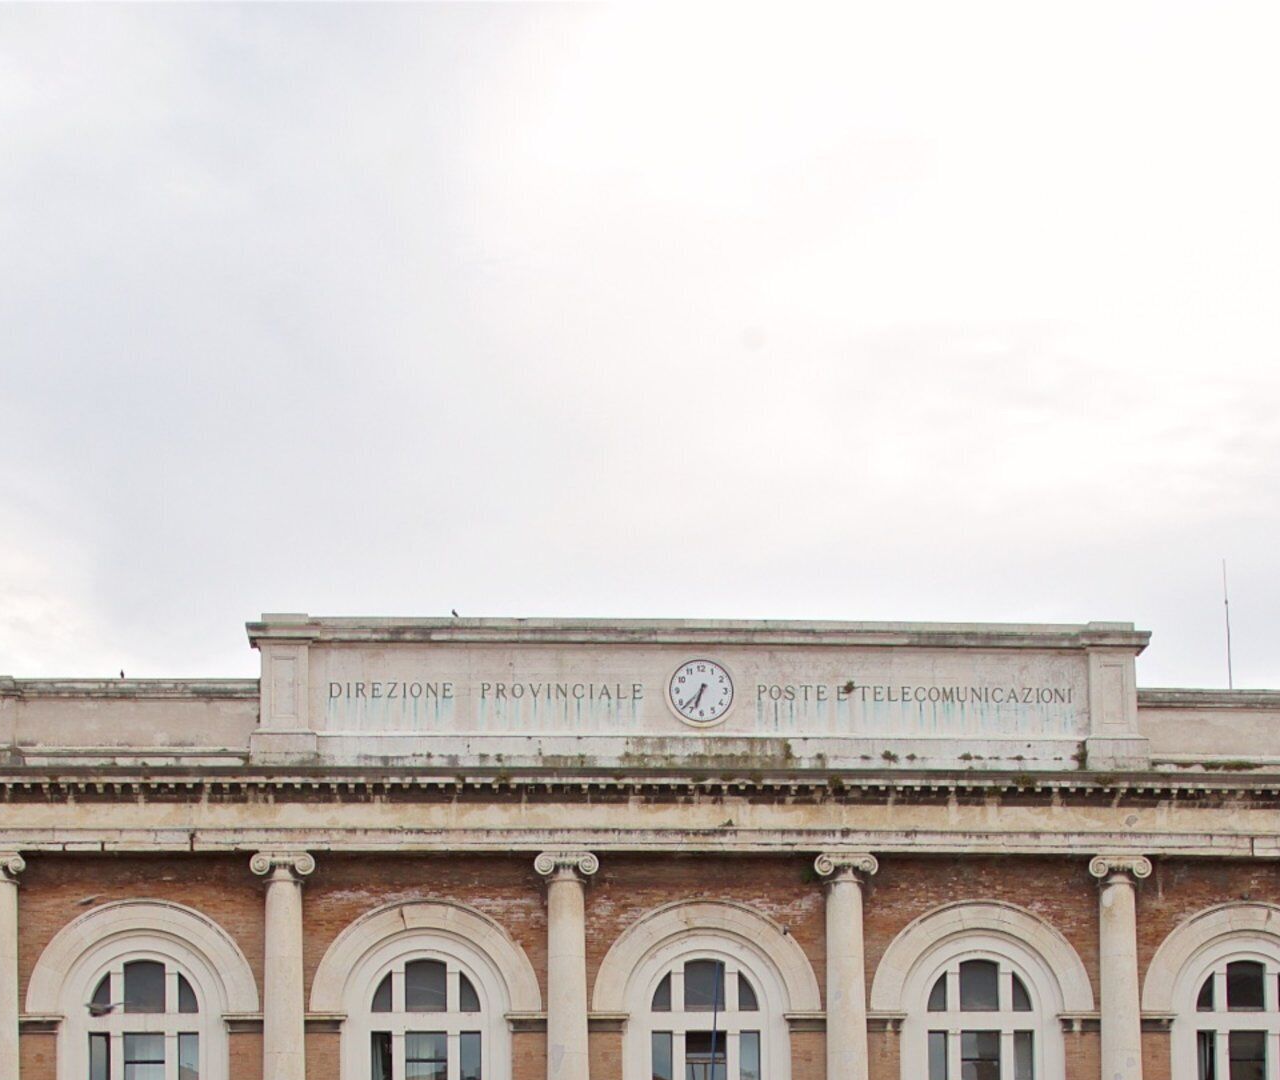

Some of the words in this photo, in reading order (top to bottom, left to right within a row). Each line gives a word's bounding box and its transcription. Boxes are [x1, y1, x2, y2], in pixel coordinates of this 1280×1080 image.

[328, 682, 454, 699] DIREZIONE
[480, 682, 644, 700] PROVINCIALE
[756, 684, 828, 701] POSTE
[836, 685, 848, 702] E
[857, 685, 1073, 703] TELECOMUNICAZIONI
